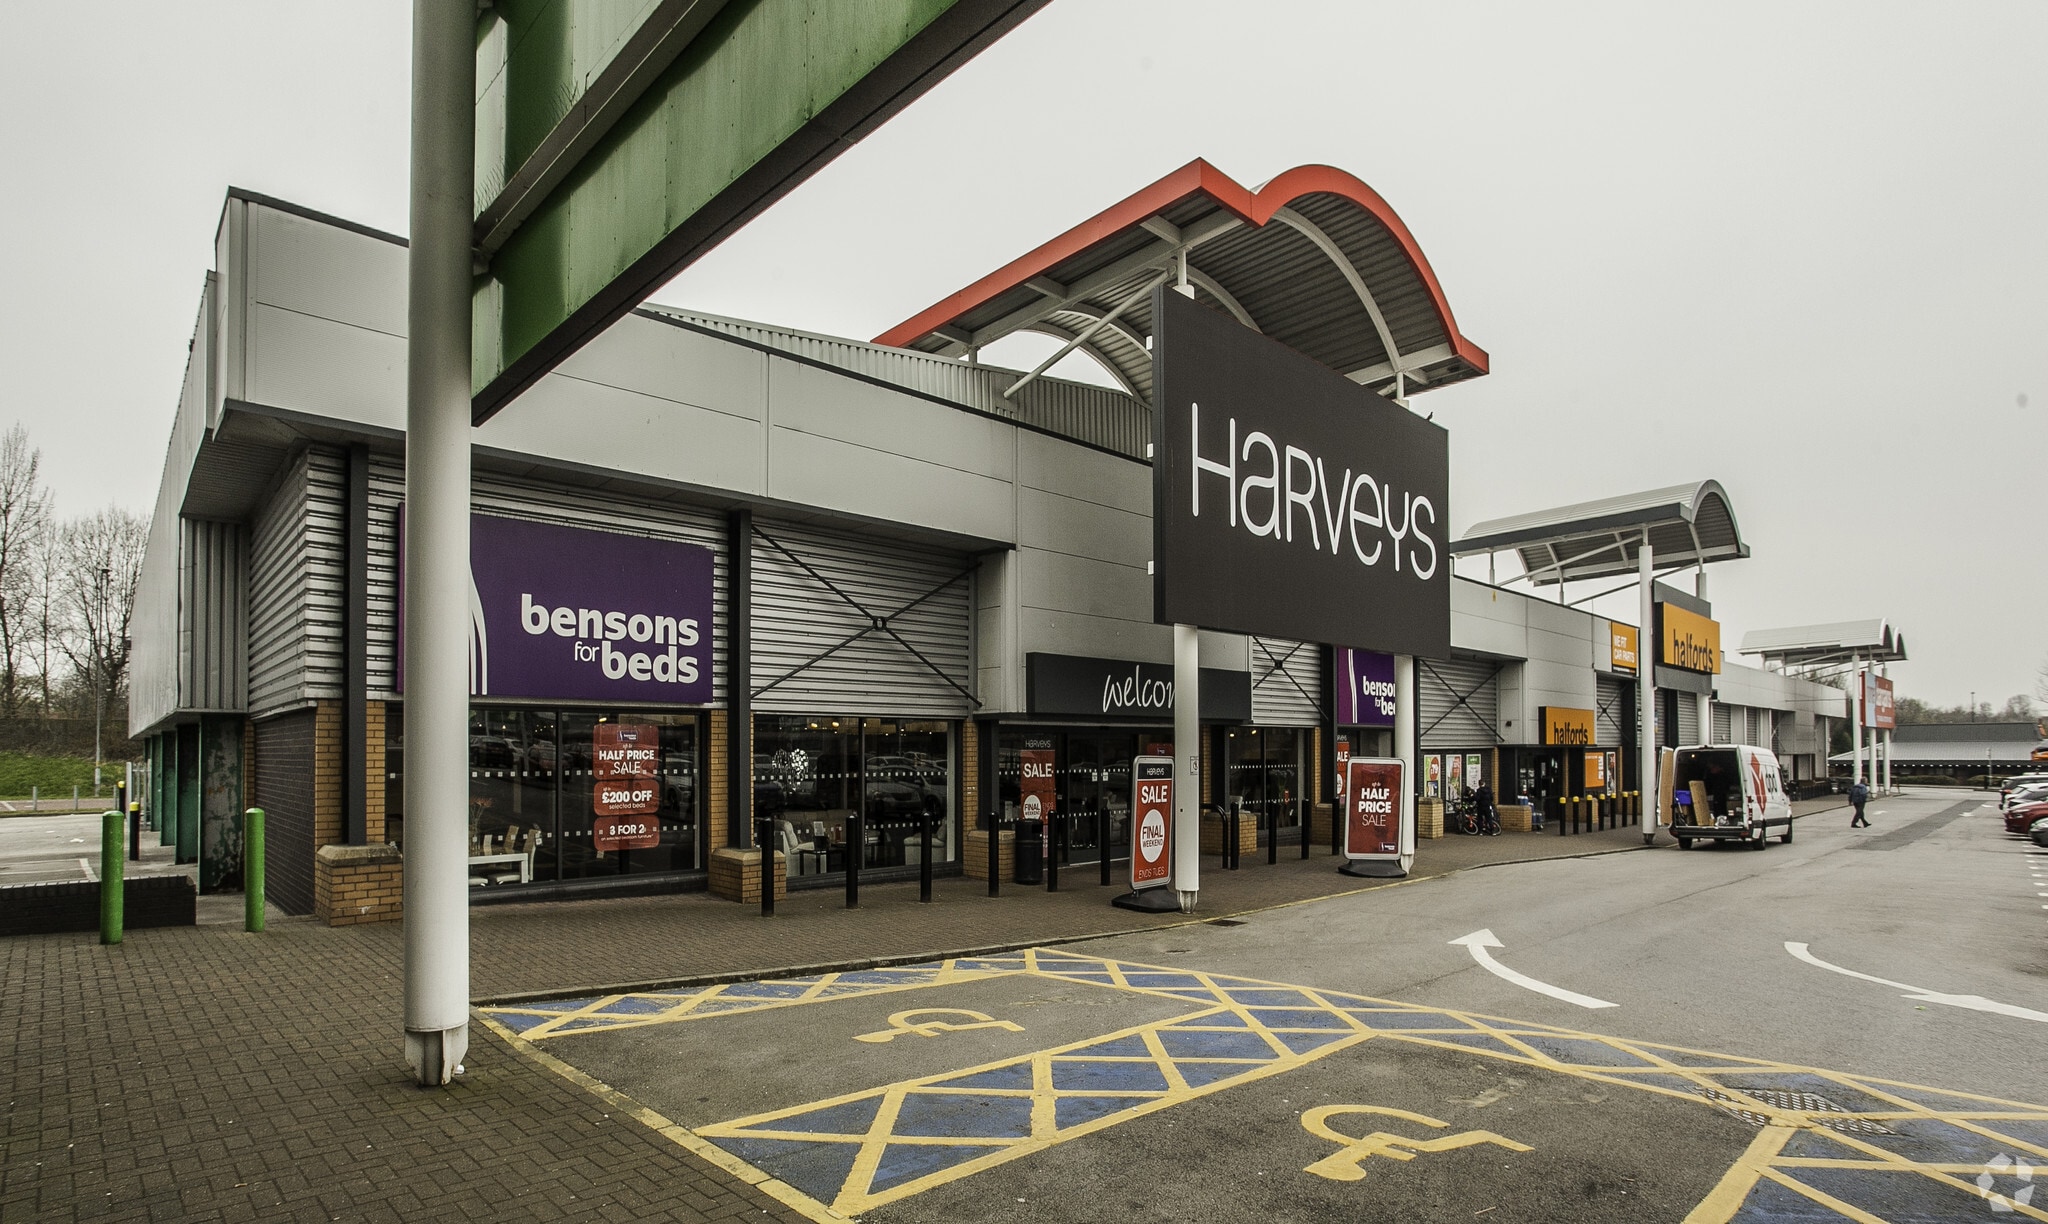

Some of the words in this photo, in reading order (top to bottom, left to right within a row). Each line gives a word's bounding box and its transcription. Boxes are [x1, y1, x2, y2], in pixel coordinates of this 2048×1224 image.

[521, 593, 699, 646] bensons
[1673, 628, 1713, 671] halfords
[574, 641, 600, 662] for
[601, 640, 699, 683] beds
[1381, 696, 1395, 715] be
[1553, 721, 1588, 744] halfords
[599, 750, 624, 760] HALF
[626, 750, 654, 760] PRICE
[1337, 751, 1348, 762] ALE
[613, 761, 641, 774] SALE
[1023, 762, 1053, 778] SALE
[602, 791, 630, 803] £200
[632, 790, 652, 802] OFF
[1141, 785, 1168, 805] SALE
[1361, 788, 1390, 800] HALF
[1024, 802, 1041, 811] FINAL
[1358, 801, 1391, 813] PRICE
[1362, 814, 1386, 826] SALE
[609, 824, 616, 836] 3
[617, 824, 636, 835] FOR
[638, 823, 645, 834] 2
[1142, 824, 1163, 839] FINAL
[1142, 838, 1163, 848] WEEKEND
[1138, 868, 1152, 879] ENDS
[1152, 866, 1165, 877] TUES
